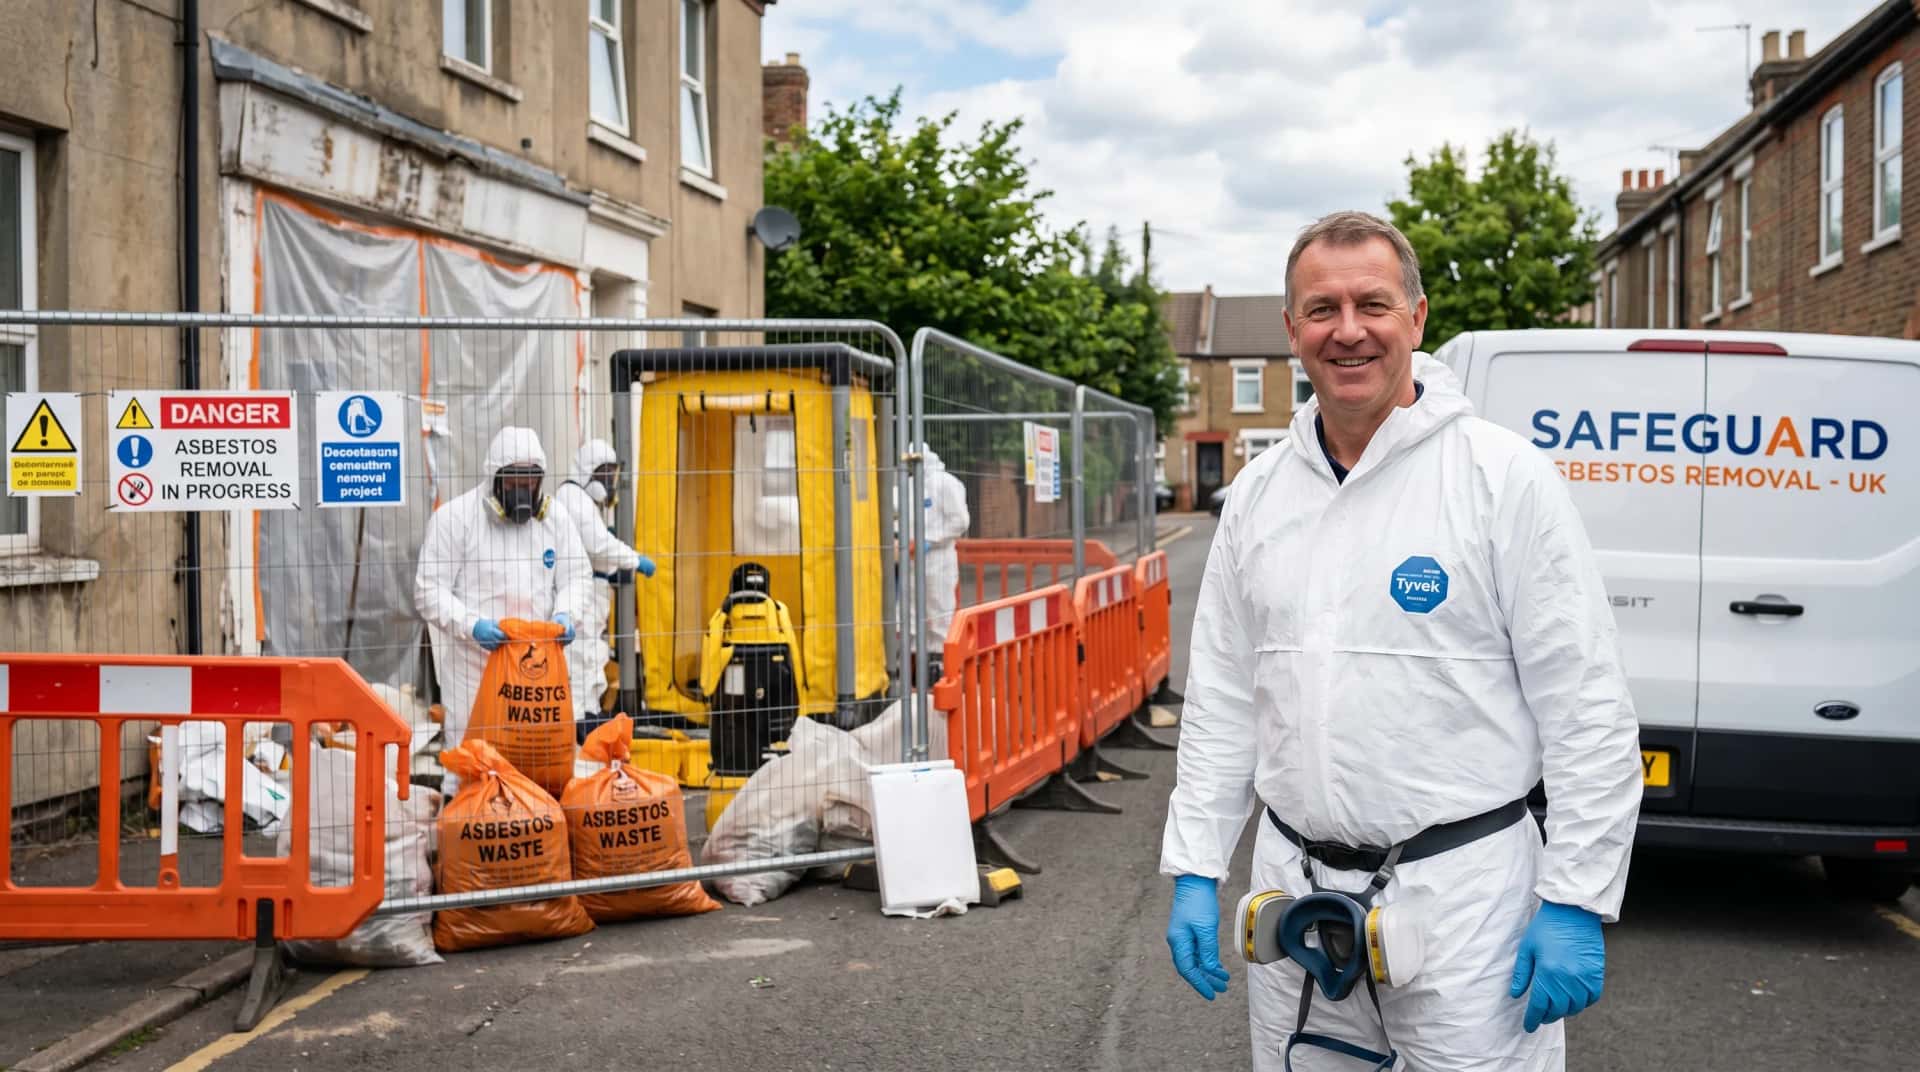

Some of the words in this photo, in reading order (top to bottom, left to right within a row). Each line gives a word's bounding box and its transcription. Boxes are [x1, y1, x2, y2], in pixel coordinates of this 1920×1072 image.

[170, 403, 281, 424] DANGER
[1531, 409, 1889, 461] SAFEGUARD
[175, 439, 278, 455] ASBESTOS
[180, 461, 273, 477] REMOVAL
[1685, 464, 1821, 491] REMOVAL
[1848, 472, 1887, 494] UK
[162, 484, 179, 500] IN
[186, 483, 291, 499] PROGRESS
[340, 485, 383, 499] project
[1396, 577, 1440, 594] Tyvek
[1608, 595, 1656, 608] SIT
[507, 705, 561, 723] WASTE
[582, 800, 670, 828] ASBESTOS
[461, 814, 554, 840] ASBESTOS
[599, 825, 662, 849] WASTE
[478, 839, 544, 863] WASTE
